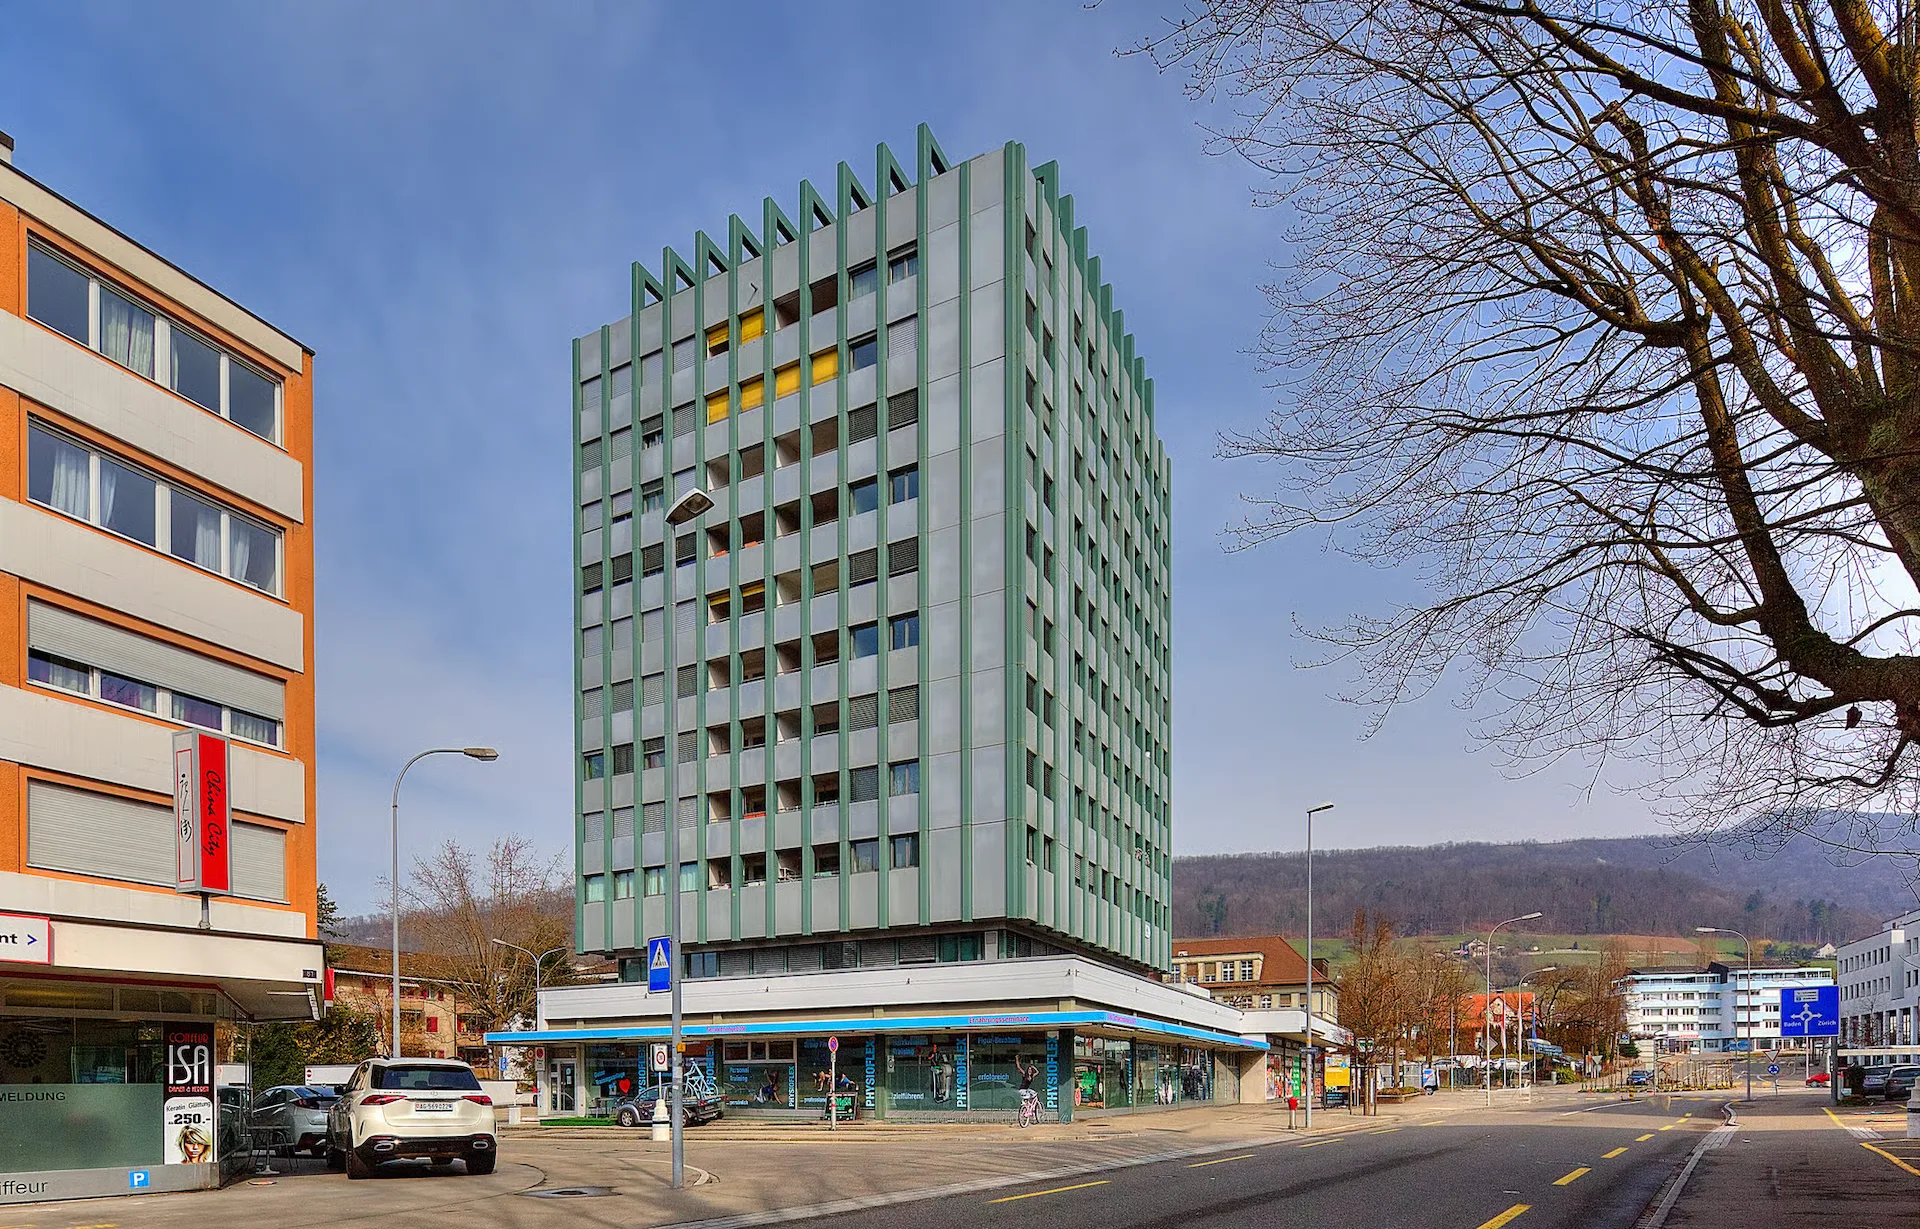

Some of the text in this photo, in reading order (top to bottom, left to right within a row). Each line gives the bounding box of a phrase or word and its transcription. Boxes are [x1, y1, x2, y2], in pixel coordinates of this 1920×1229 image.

[202, 770, 222, 857] China City
[169, 1032, 208, 1043] COIFFEUR
[168, 1045, 209, 1085] ISA
[866, 1040, 875, 1107] PHYSIOFLEX
[956, 1037, 967, 1108] PHYSIOFLEX
[1047, 1036, 1058, 1108] PHYSIOFLEX
[166, 1104, 186, 1112] Keratin
[133, 1172, 145, 1186] P
